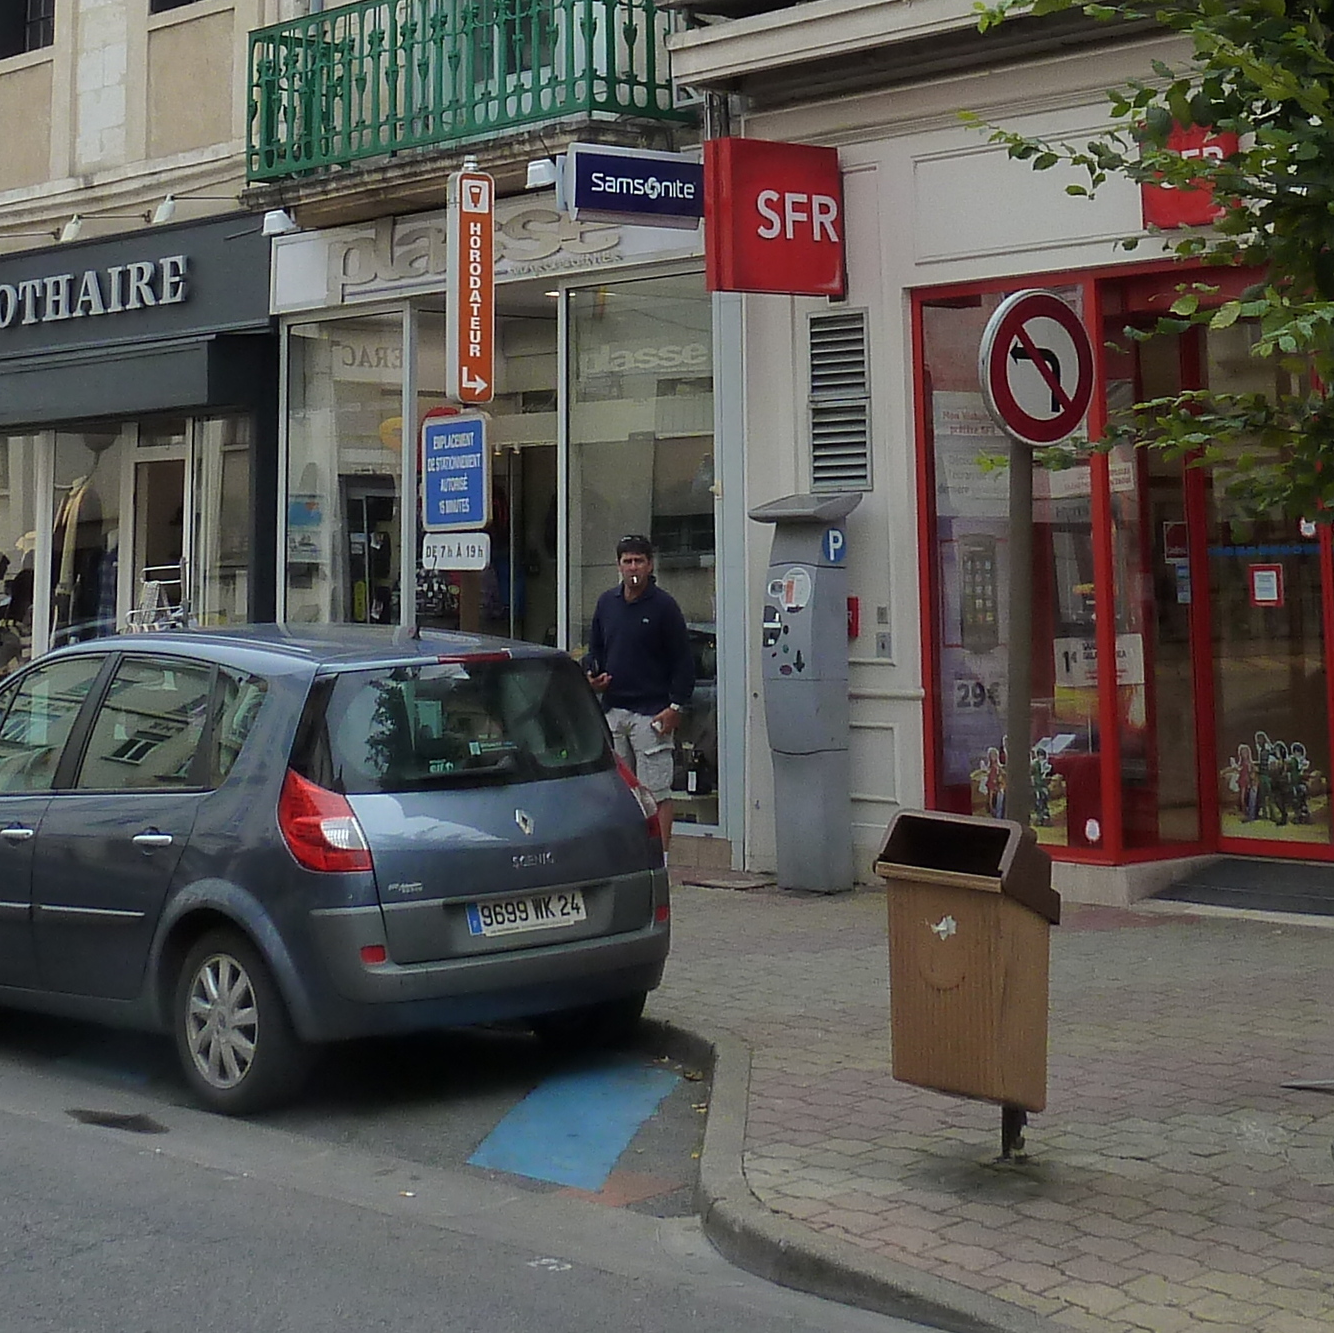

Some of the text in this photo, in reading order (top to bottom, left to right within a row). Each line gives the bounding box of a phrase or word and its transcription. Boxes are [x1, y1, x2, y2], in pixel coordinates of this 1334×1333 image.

[757, 189, 839, 243] SFR
[470, 222, 482, 357] HORODATEUR
[433, 432, 474, 450] EMPLACEMENT
[436, 454, 481, 471] STATIONNEMENT
[440, 473, 468, 492] AUTORISÉ
[446, 498, 470, 514] MINUTES
[426, 546, 437, 559] DE
[829, 530, 843, 560] P
[957, 682, 1001, 709] 29€
[481, 894, 581, 926] 9699 WK 24
